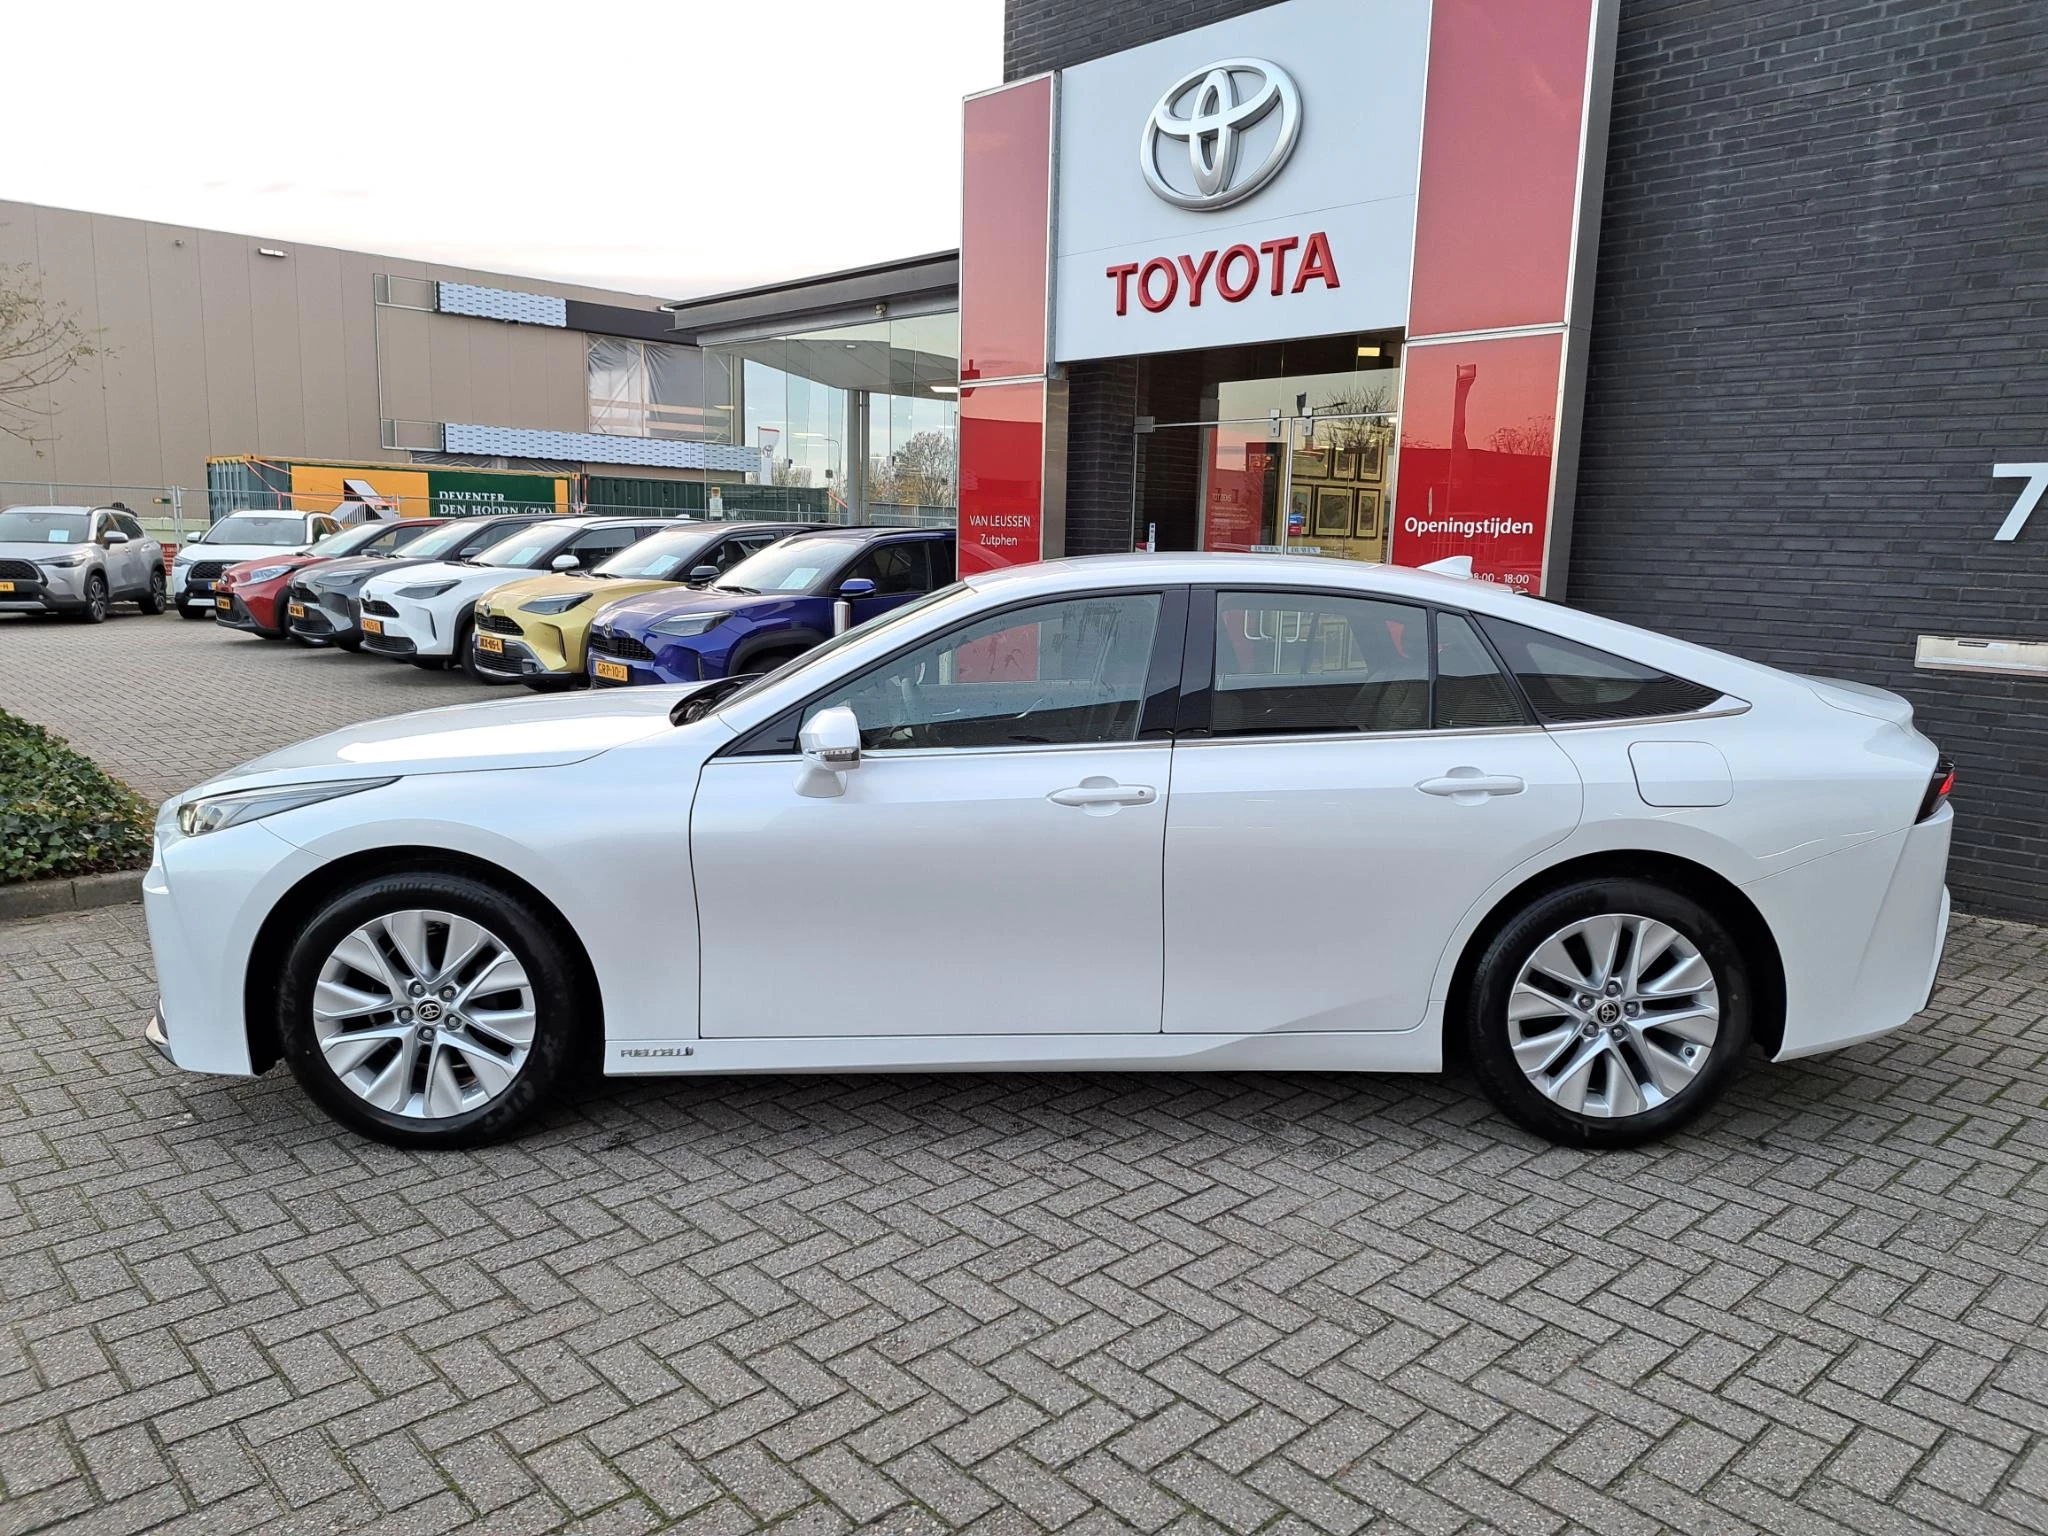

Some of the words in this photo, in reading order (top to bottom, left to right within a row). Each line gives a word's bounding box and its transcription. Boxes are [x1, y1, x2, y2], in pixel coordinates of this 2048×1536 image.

[1106, 231, 1341, 316] TOYOTA
[438, 491, 505, 502] DEVENTER
[1993, 463, 2048, 541] 7
[439, 504, 456, 514] DEN
[472, 505, 519, 515] HOORN
[969, 514, 988, 527] VAN
[990, 515, 1031, 528] LEUSSEN
[1404, 516, 1534, 539] Openingstijden
[980, 533, 1018, 548] Zutphen
[1503, 573, 1530, 584] 18:00
[597, 662, 625, 679] GRP-10-J
